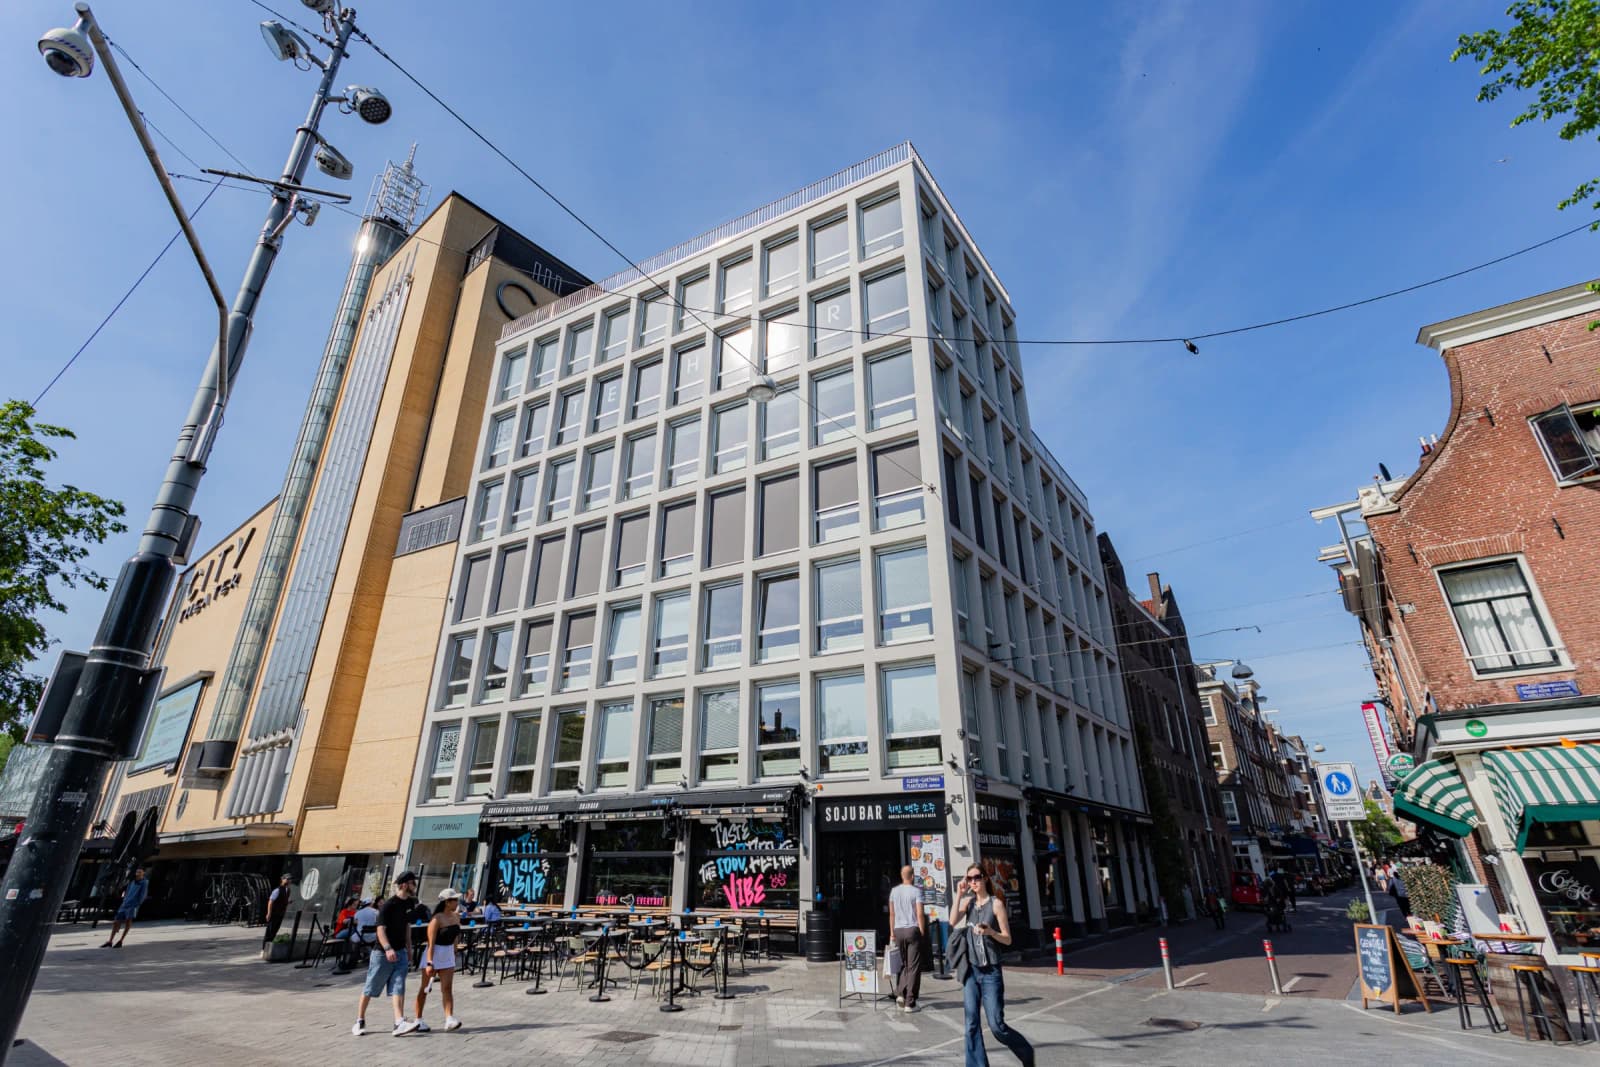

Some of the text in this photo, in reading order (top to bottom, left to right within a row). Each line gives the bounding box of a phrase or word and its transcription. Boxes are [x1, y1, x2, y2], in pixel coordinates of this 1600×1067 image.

[187, 526, 257, 602] CITY
[178, 572, 243, 624] THEATER
[825, 804, 883, 822] SOJU BAR
[950, 793, 964, 804] 25
[710, 821, 751, 849] TASTE
[512, 868, 546, 903] BAR
[698, 859, 718, 884] THE
[722, 872, 767, 913] VIBE
